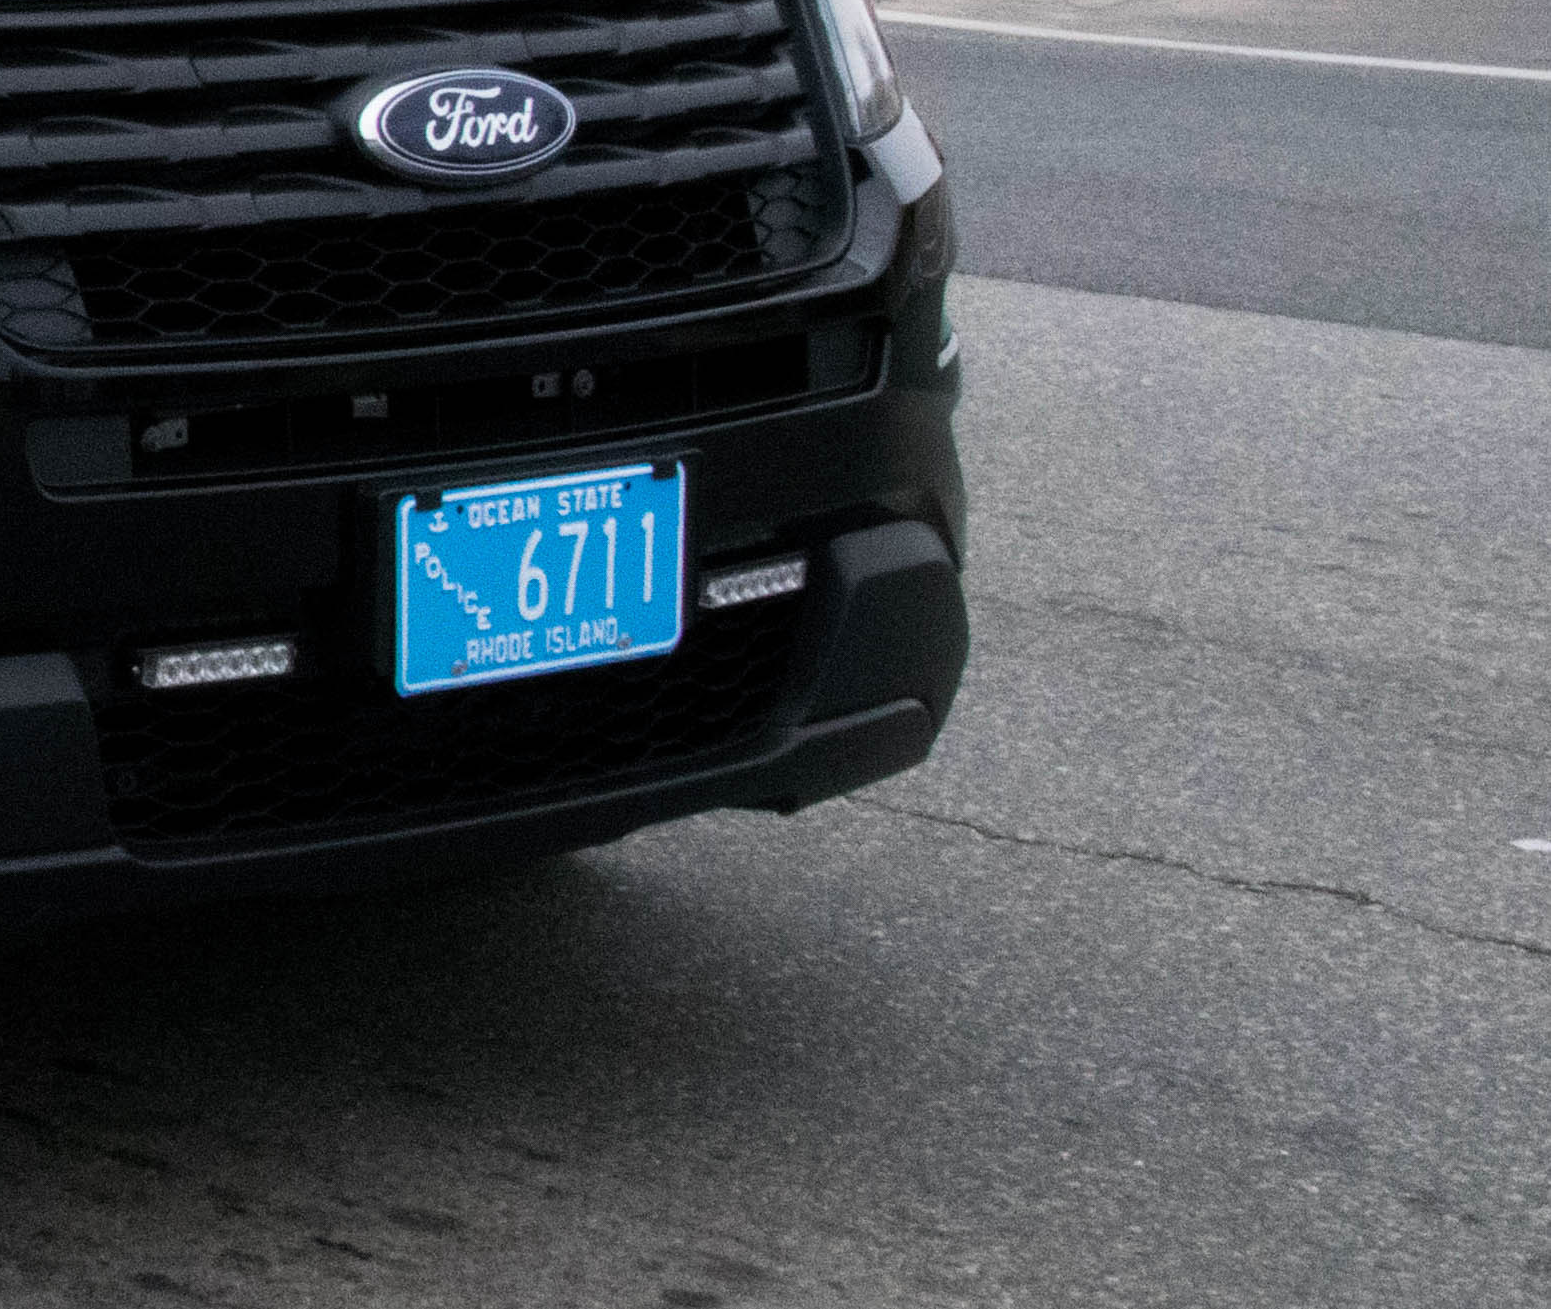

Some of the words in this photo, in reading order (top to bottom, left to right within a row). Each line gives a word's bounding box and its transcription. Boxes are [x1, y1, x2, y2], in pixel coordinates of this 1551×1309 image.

[426, 87, 538, 151] Ford
[468, 494, 540, 529] OCEAN
[558, 482, 623, 516] STATE
[414, 542, 492, 630] POLICE
[517, 511, 655, 622] 6711
[466, 629, 534, 667] RHODE
[546, 616, 619, 655] ISLAND
